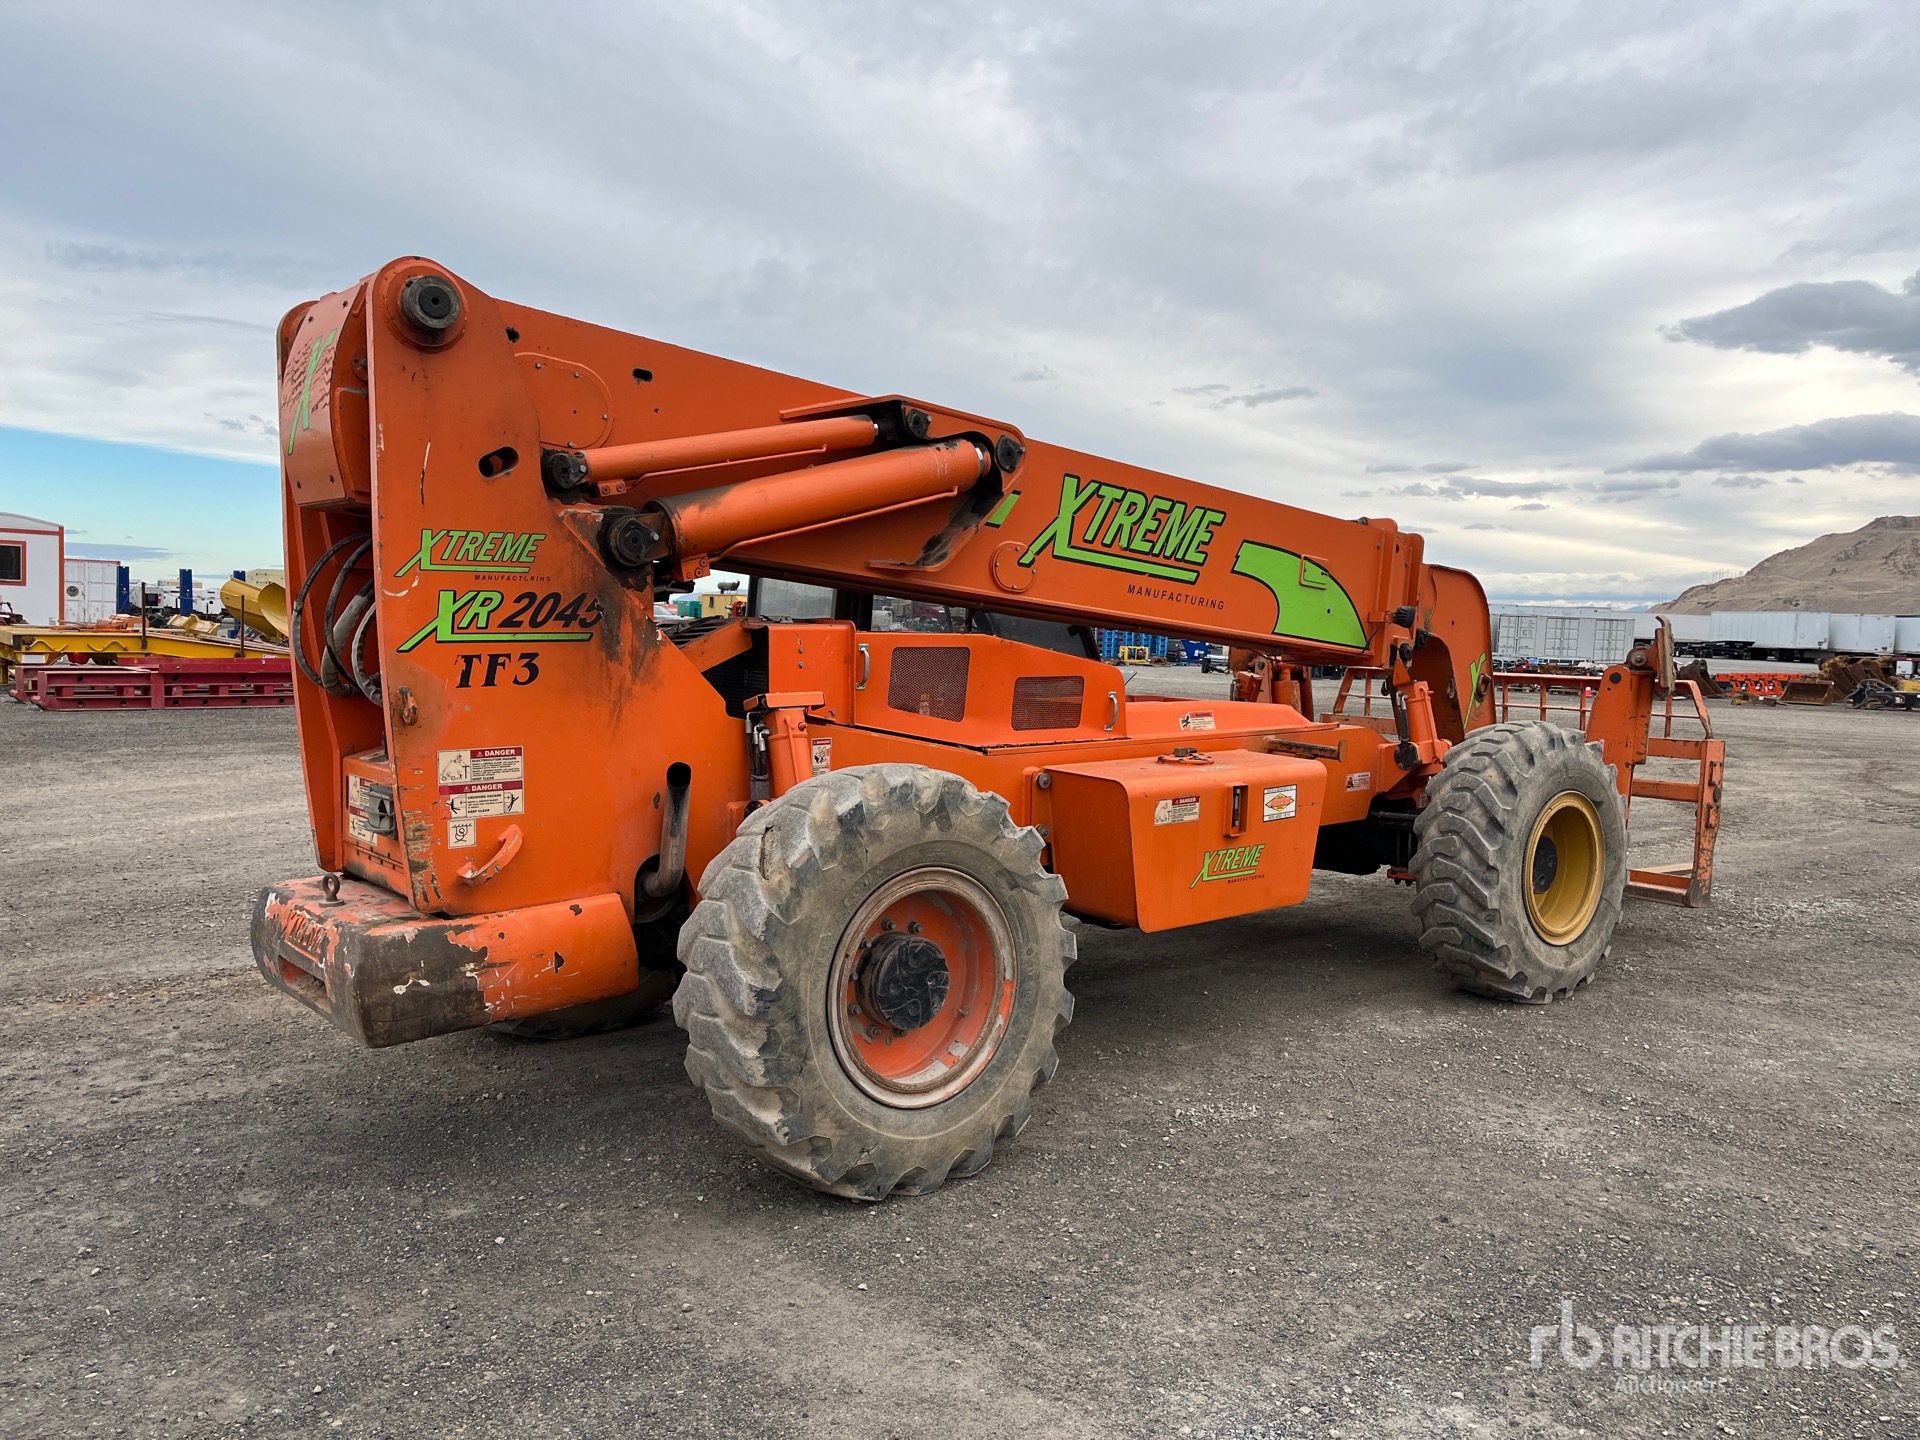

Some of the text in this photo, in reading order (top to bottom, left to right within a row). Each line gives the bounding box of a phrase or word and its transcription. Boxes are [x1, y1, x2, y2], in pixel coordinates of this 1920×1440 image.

[1017, 473, 1227, 585] XTREME
[394, 529, 547, 577] XTREME
[497, 591, 604, 629] 2045
[1127, 584, 1226, 610] MANUFACTURING
[454, 652, 540, 688] TF3
[484, 749, 516, 757] DANGER
[1189, 843, 1266, 889] XTREME
[1227, 874, 1265, 884] MANUFACTURING
